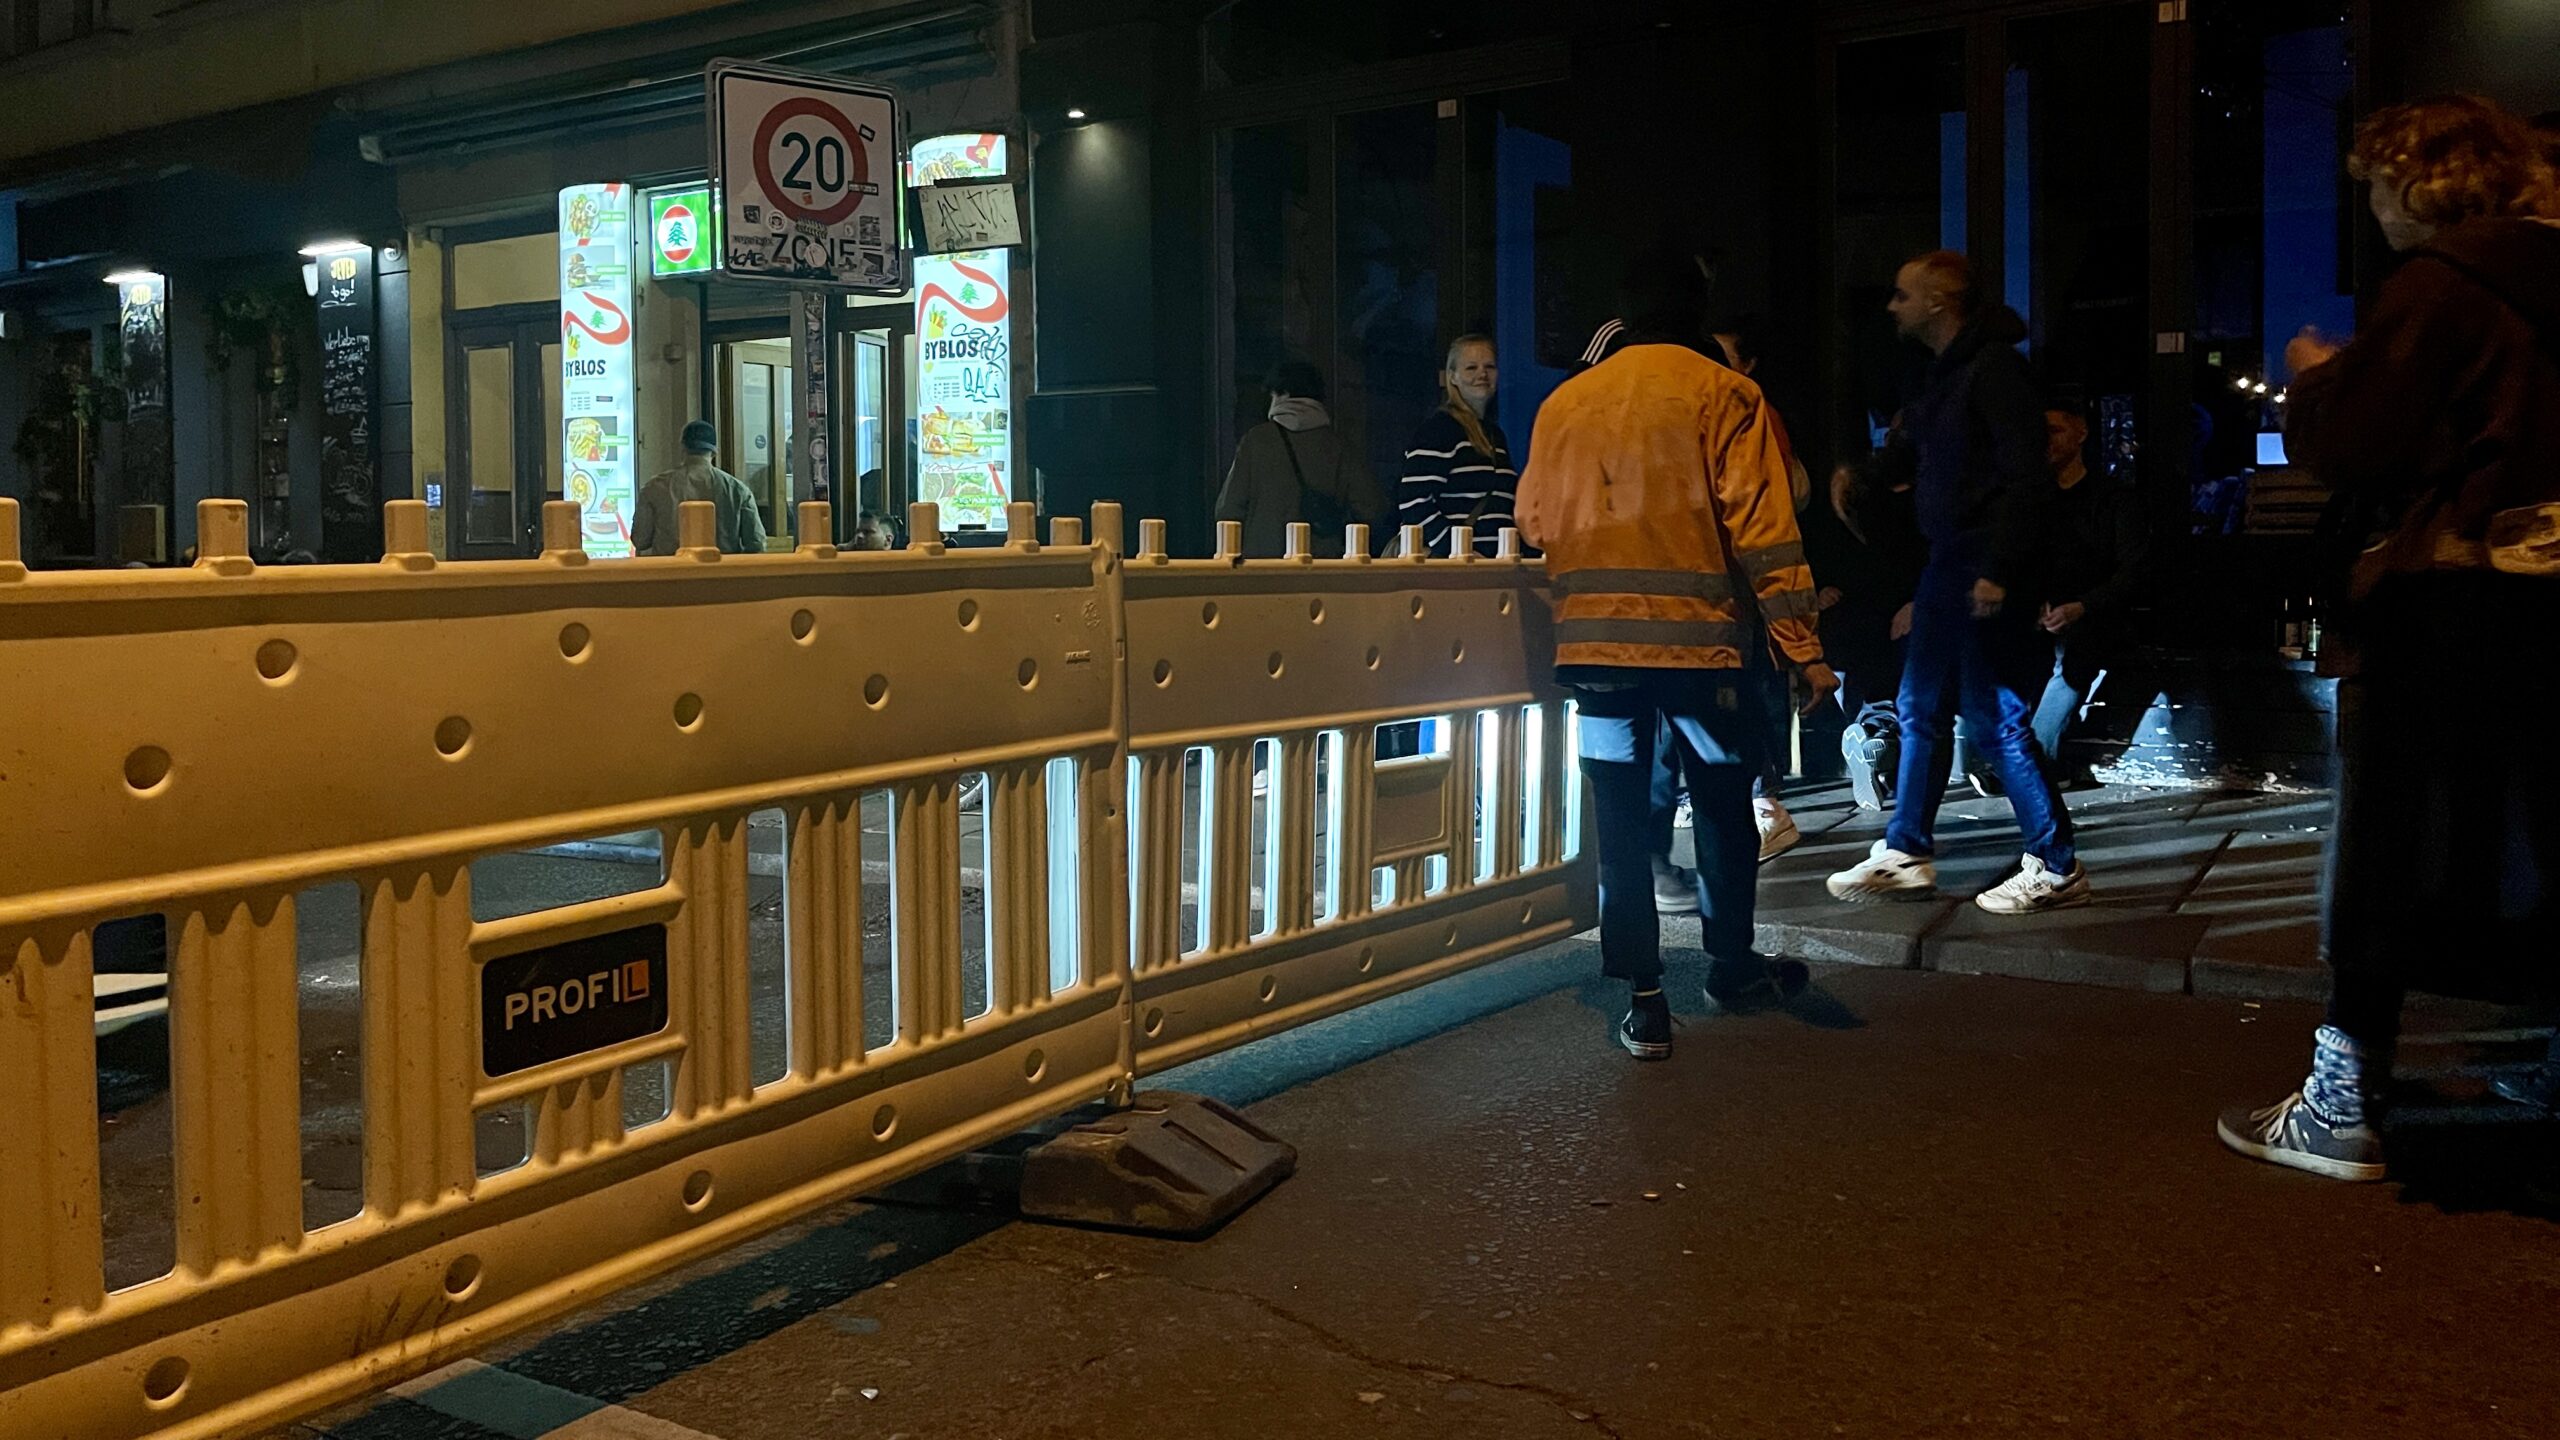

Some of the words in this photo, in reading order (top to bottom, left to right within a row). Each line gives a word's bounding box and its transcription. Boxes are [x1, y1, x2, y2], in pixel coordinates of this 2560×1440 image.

[781, 131, 845, 193] 20
[771, 233, 857, 268] ZONE
[925, 339, 979, 361] BYBLOS
[505, 960, 649, 1031] PROFIL
